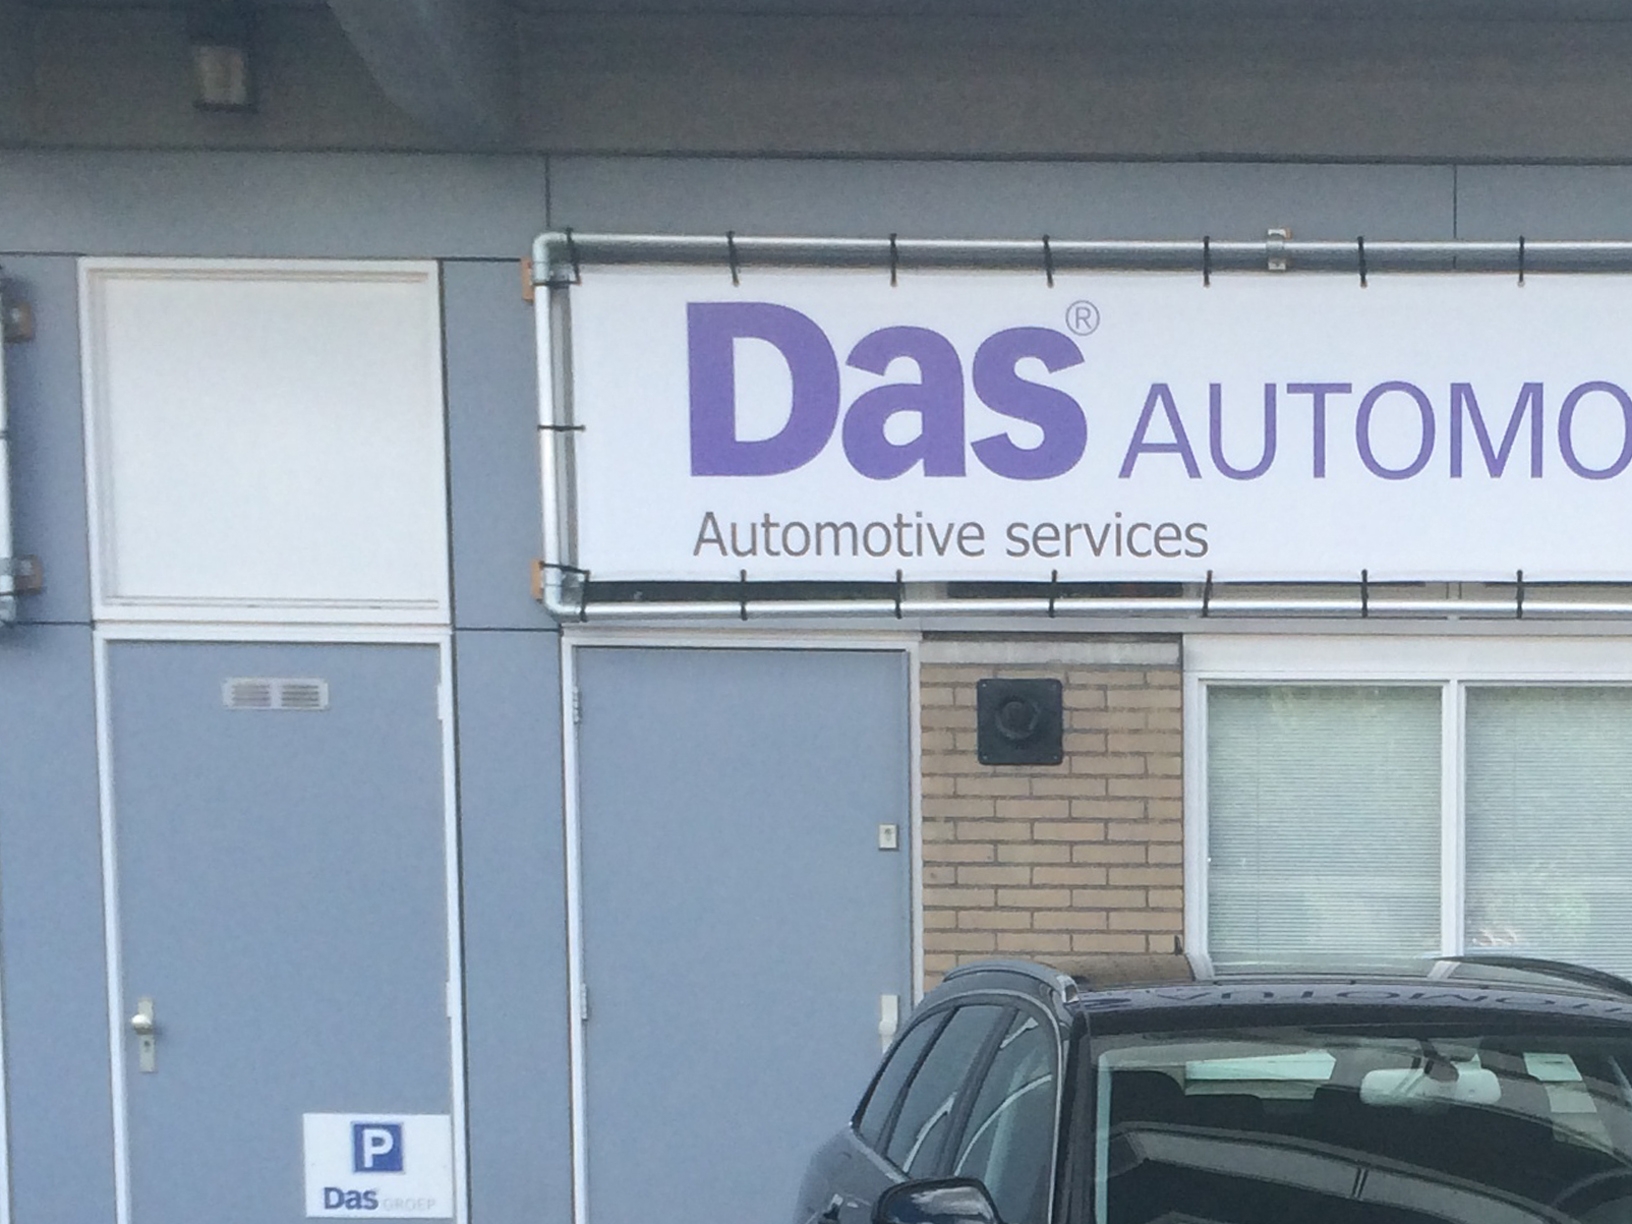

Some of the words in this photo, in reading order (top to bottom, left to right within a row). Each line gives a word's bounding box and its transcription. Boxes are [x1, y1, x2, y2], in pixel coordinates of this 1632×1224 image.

[693, 511, 986, 558] Automotive
[1006, 511, 1209, 558] services
[362, 1128, 394, 1168] P
[323, 1186, 379, 1211] Das
